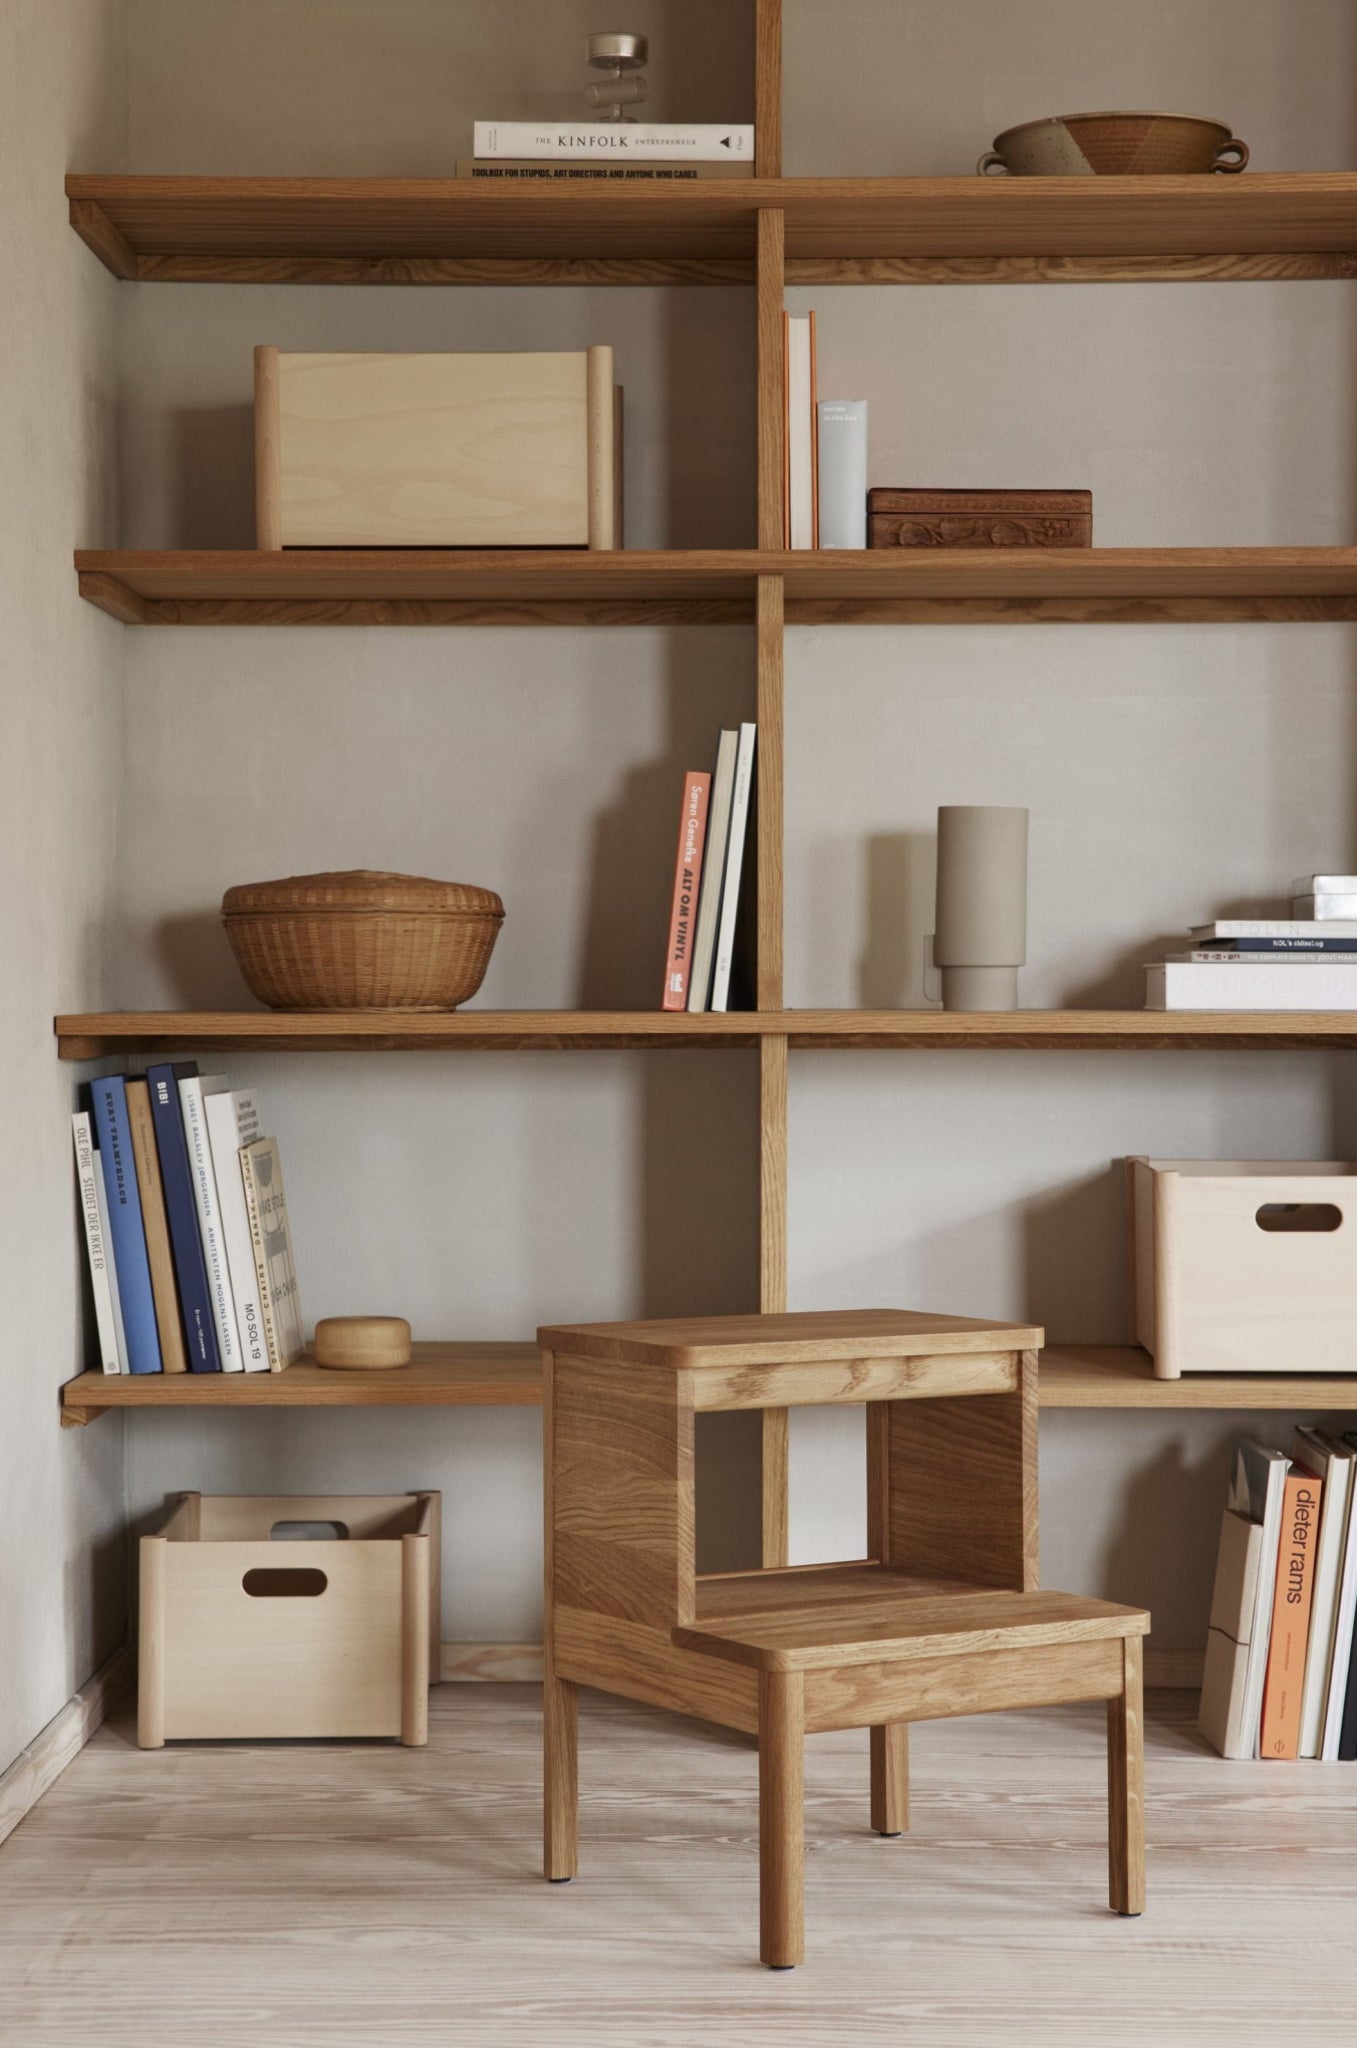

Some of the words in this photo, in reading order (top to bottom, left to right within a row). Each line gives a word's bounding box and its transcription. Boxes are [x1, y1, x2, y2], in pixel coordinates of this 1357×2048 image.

[557, 136, 628, 147] KINFOLK
[472, 168, 504, 177] TOOLBOX
[505, 169, 518, 177] FOR
[520, 169, 552, 178] STUPIDS,
[553, 169, 567, 178] ART
[568, 169, 607, 178] DIRECTORS
[609, 170, 624, 178] AND
[625, 170, 654, 178] ANYONE
[655, 170, 673, 178] WHO
[674, 170, 697, 178] CARES
[682, 868, 693, 892] ALT
[679, 896, 691, 917] OM
[1224, 922, 1300, 936] STOLEN
[674, 920, 688, 961] VINYL
[157, 1082, 169, 1104] BIBI
[188, 1094, 198, 1123] LISBET
[77, 1127, 88, 1145] OLE
[192, 1127, 204, 1163] BALSLEV
[80, 1147, 91, 1168] PIHL
[105, 1092, 115, 1123] KURT
[110, 1127, 127, 1205] TRAMPEDACH
[83, 1177, 96, 1210] STEDET
[197, 1167, 211, 1216] JØRGENSEN
[88, 1213, 99, 1231] DER
[90, 1234, 102, 1256] IKKE
[93, 1258, 104, 1270] ER
[207, 1227, 221, 1280] ARKITEKTEN
[216, 1283, 226, 1320] MOGENS
[222, 1323, 232, 1355] LASSEN
[258, 1264, 269, 1309] CHAIRS
[245, 1303, 255, 1322] MO
[247, 1324, 258, 1345] SOL
[266, 1318, 277, 1364] DANISH
[252, 1348, 261, 1359] 19
[1293, 1489, 1315, 1549] dieter
[1286, 1552, 1306, 1604] rams
